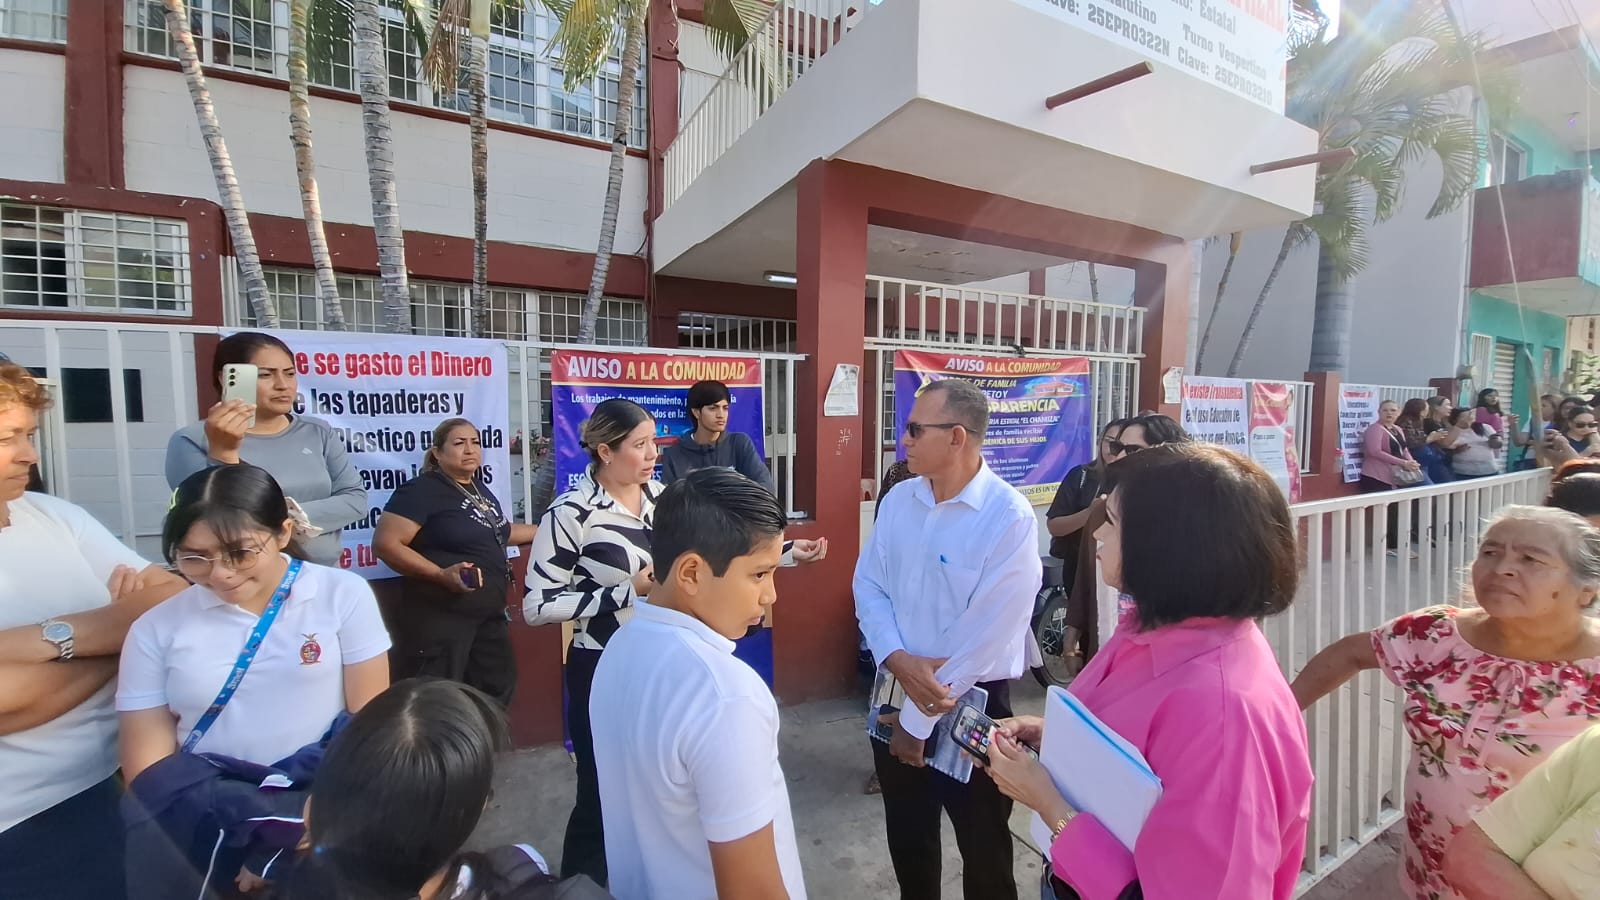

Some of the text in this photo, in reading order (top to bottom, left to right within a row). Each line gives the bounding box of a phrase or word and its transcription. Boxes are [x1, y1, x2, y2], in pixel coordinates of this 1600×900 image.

[1106, 0, 1157, 24] atutino
[1182, 23, 1214, 53] Turno
[1177, 46, 1209, 77] Clave:
[313, 352, 340, 375] se
[345, 351, 403, 379] gasto
[408, 350, 427, 376] el
[431, 350, 492, 377] Dinero
[567, 355, 746, 381] AVISO A LA COMUNIDAD
[945, 357, 1062, 374] AVISO A LA COMUNIDAD
[986, 379, 1017, 388] FAMILIA
[310, 388, 344, 415] las
[347, 388, 450, 418] tapaderas
[454, 392, 464, 416] y
[571, 393, 584, 404] Los
[667, 410, 676, 419] en
